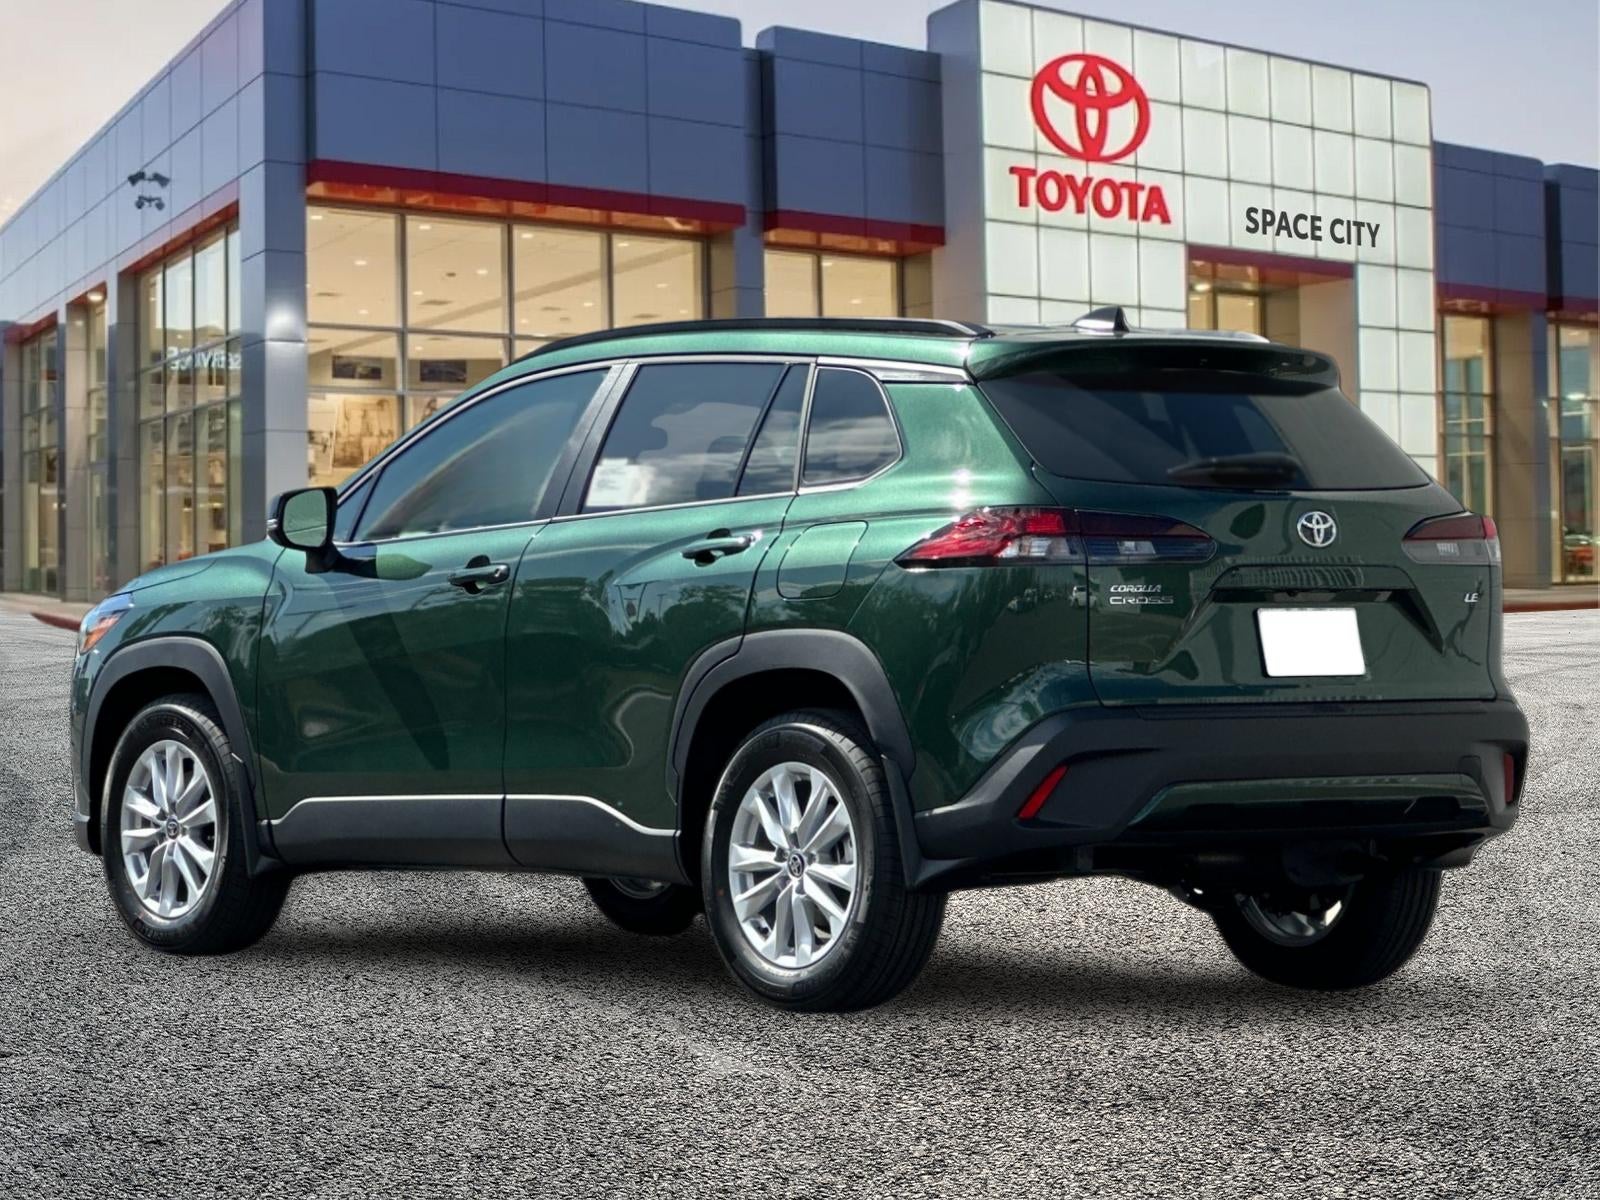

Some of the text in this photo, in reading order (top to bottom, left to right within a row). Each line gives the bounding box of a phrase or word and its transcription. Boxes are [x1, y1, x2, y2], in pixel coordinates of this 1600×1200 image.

[1009, 166, 1171, 224] TOYOTA
[1245, 206, 1380, 248] SPACE CITY
[1110, 584, 1162, 593] COROLLA
[1109, 596, 1174, 605] CROSS
[1464, 592, 1479, 603] LE
